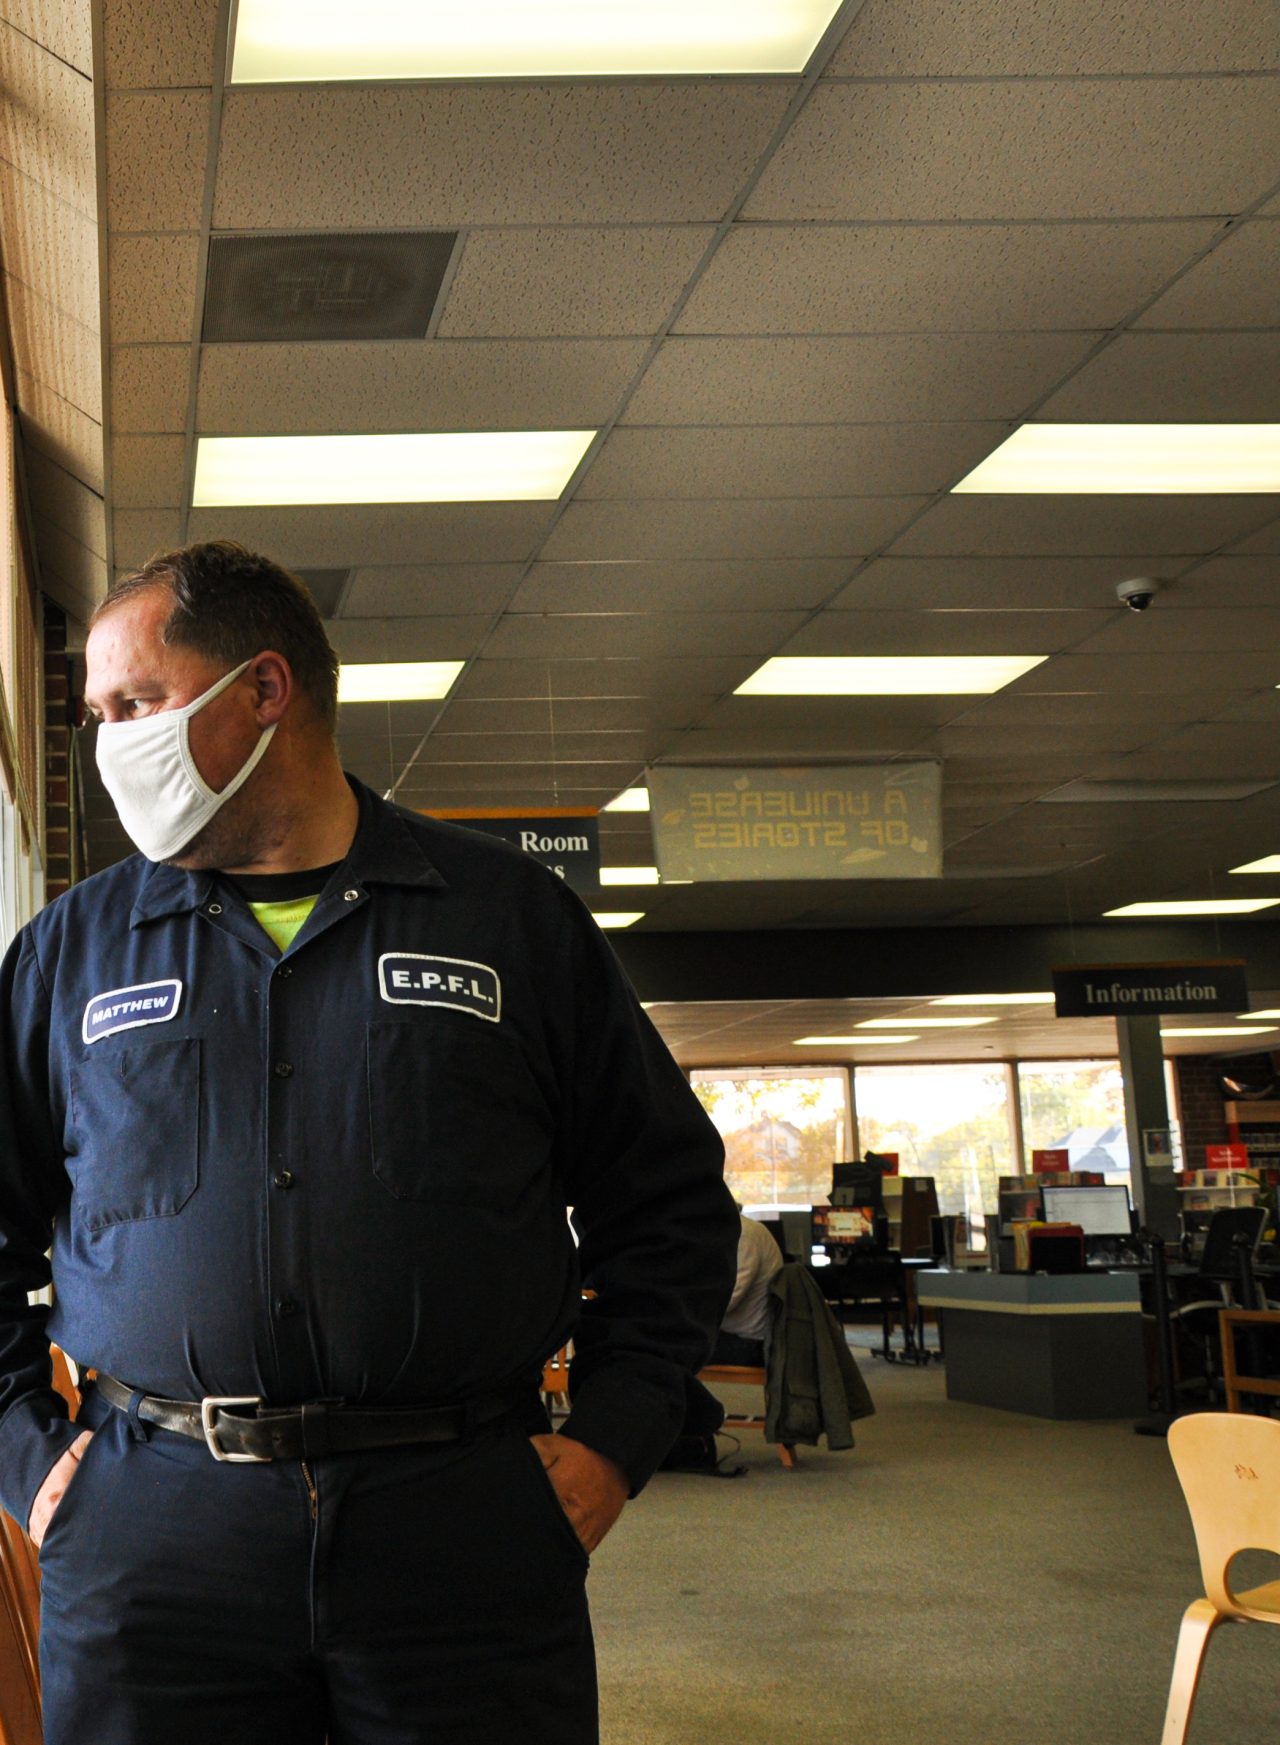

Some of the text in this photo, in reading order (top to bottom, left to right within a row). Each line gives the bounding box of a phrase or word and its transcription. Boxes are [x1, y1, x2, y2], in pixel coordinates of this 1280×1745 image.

[519, 831, 589, 852] Room
[391, 970, 494, 1004] E.P.F.L.
[1085, 981, 1218, 1004] Information
[92, 996, 169, 1025] MATTHEW
